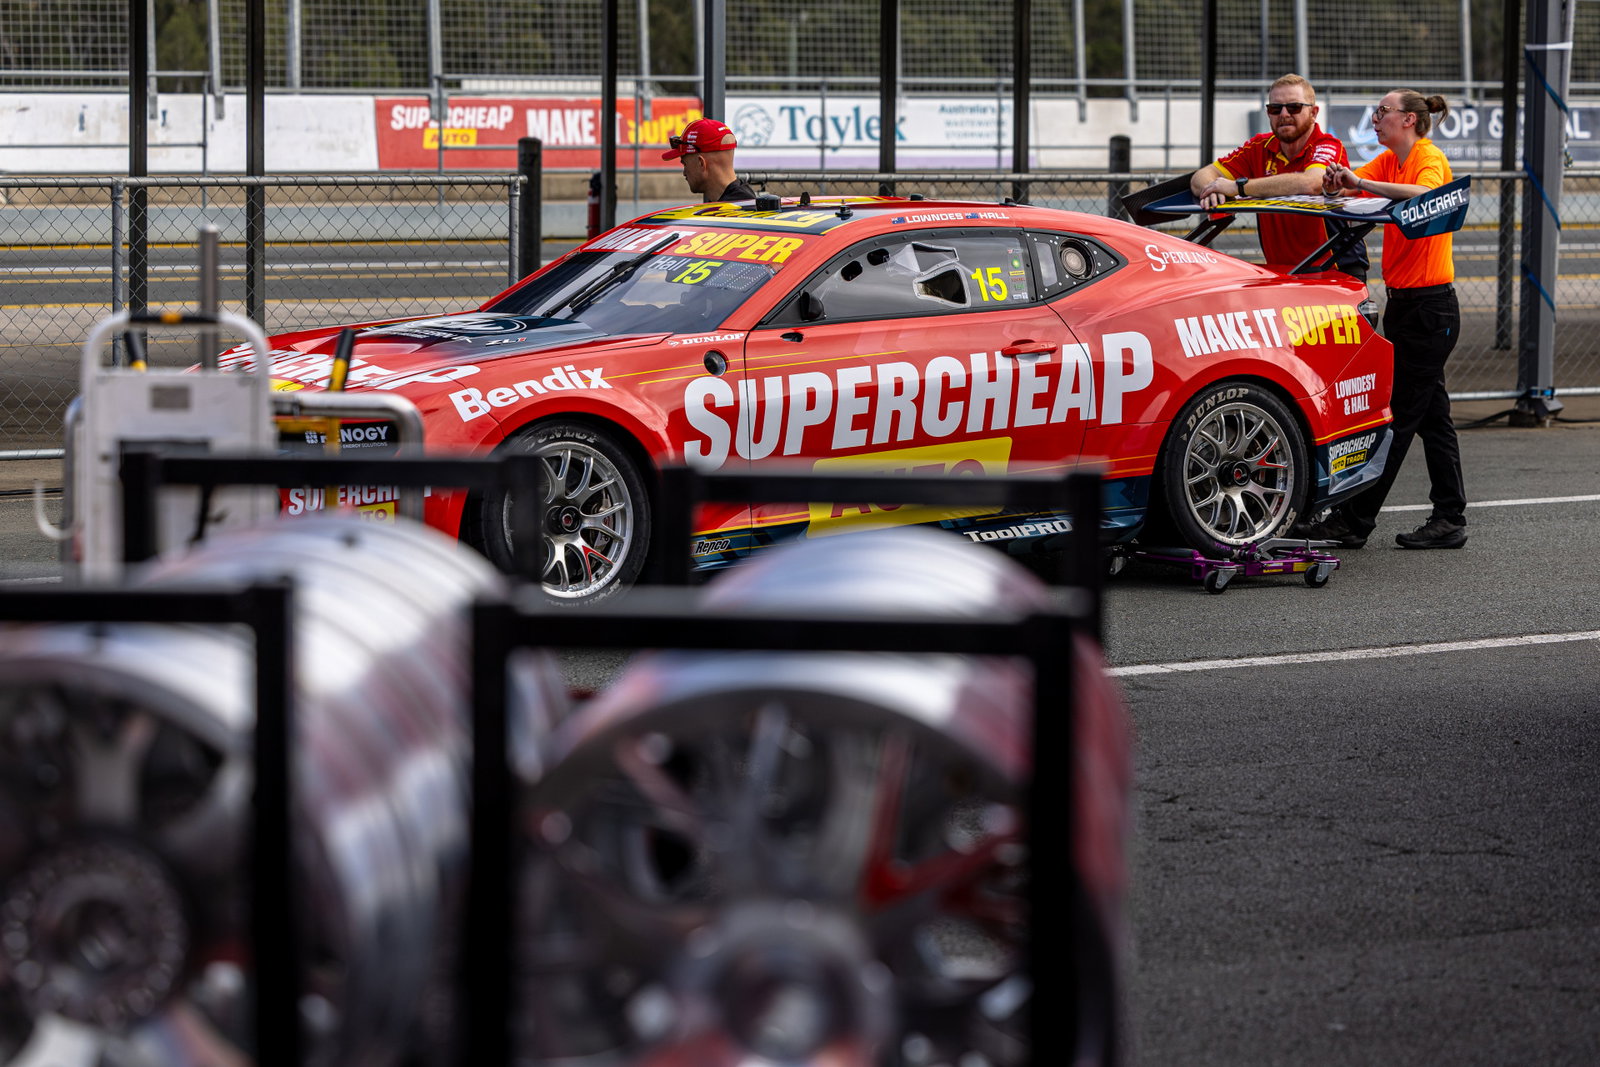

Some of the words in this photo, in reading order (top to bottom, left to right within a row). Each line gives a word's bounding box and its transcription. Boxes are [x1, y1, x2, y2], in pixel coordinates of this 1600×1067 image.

[391, 105, 514, 131] SUPRCHEAP
[526, 109, 597, 145] MAKE
[906, 212, 963, 224] LOWNDES
[978, 211, 1009, 220] HALL
[674, 232, 804, 265] SUPER
[647, 256, 692, 271] Hall
[671, 260, 724, 284] 15
[970, 267, 1008, 301] 15
[681, 333, 744, 345] DUNLOP
[1174, 311, 1260, 358] MAKE
[1253, 308, 1283, 348] IT
[1281, 304, 1362, 347] SUPER
[448, 364, 613, 423] Bendix
[1335, 372, 1376, 399] LOWNDESY
[684, 331, 1154, 471] SUPERCHEAP
[1187, 387, 1249, 431] DUNLOP
[1344, 398, 1351, 416] &
[1351, 393, 1370, 414] HALL
[320, 426, 388, 444] NOGY
[1329, 432, 1377, 461] SUPERCHEAP
[963, 519, 1073, 543] ToolPRO
[696, 539, 730, 556] Repco
